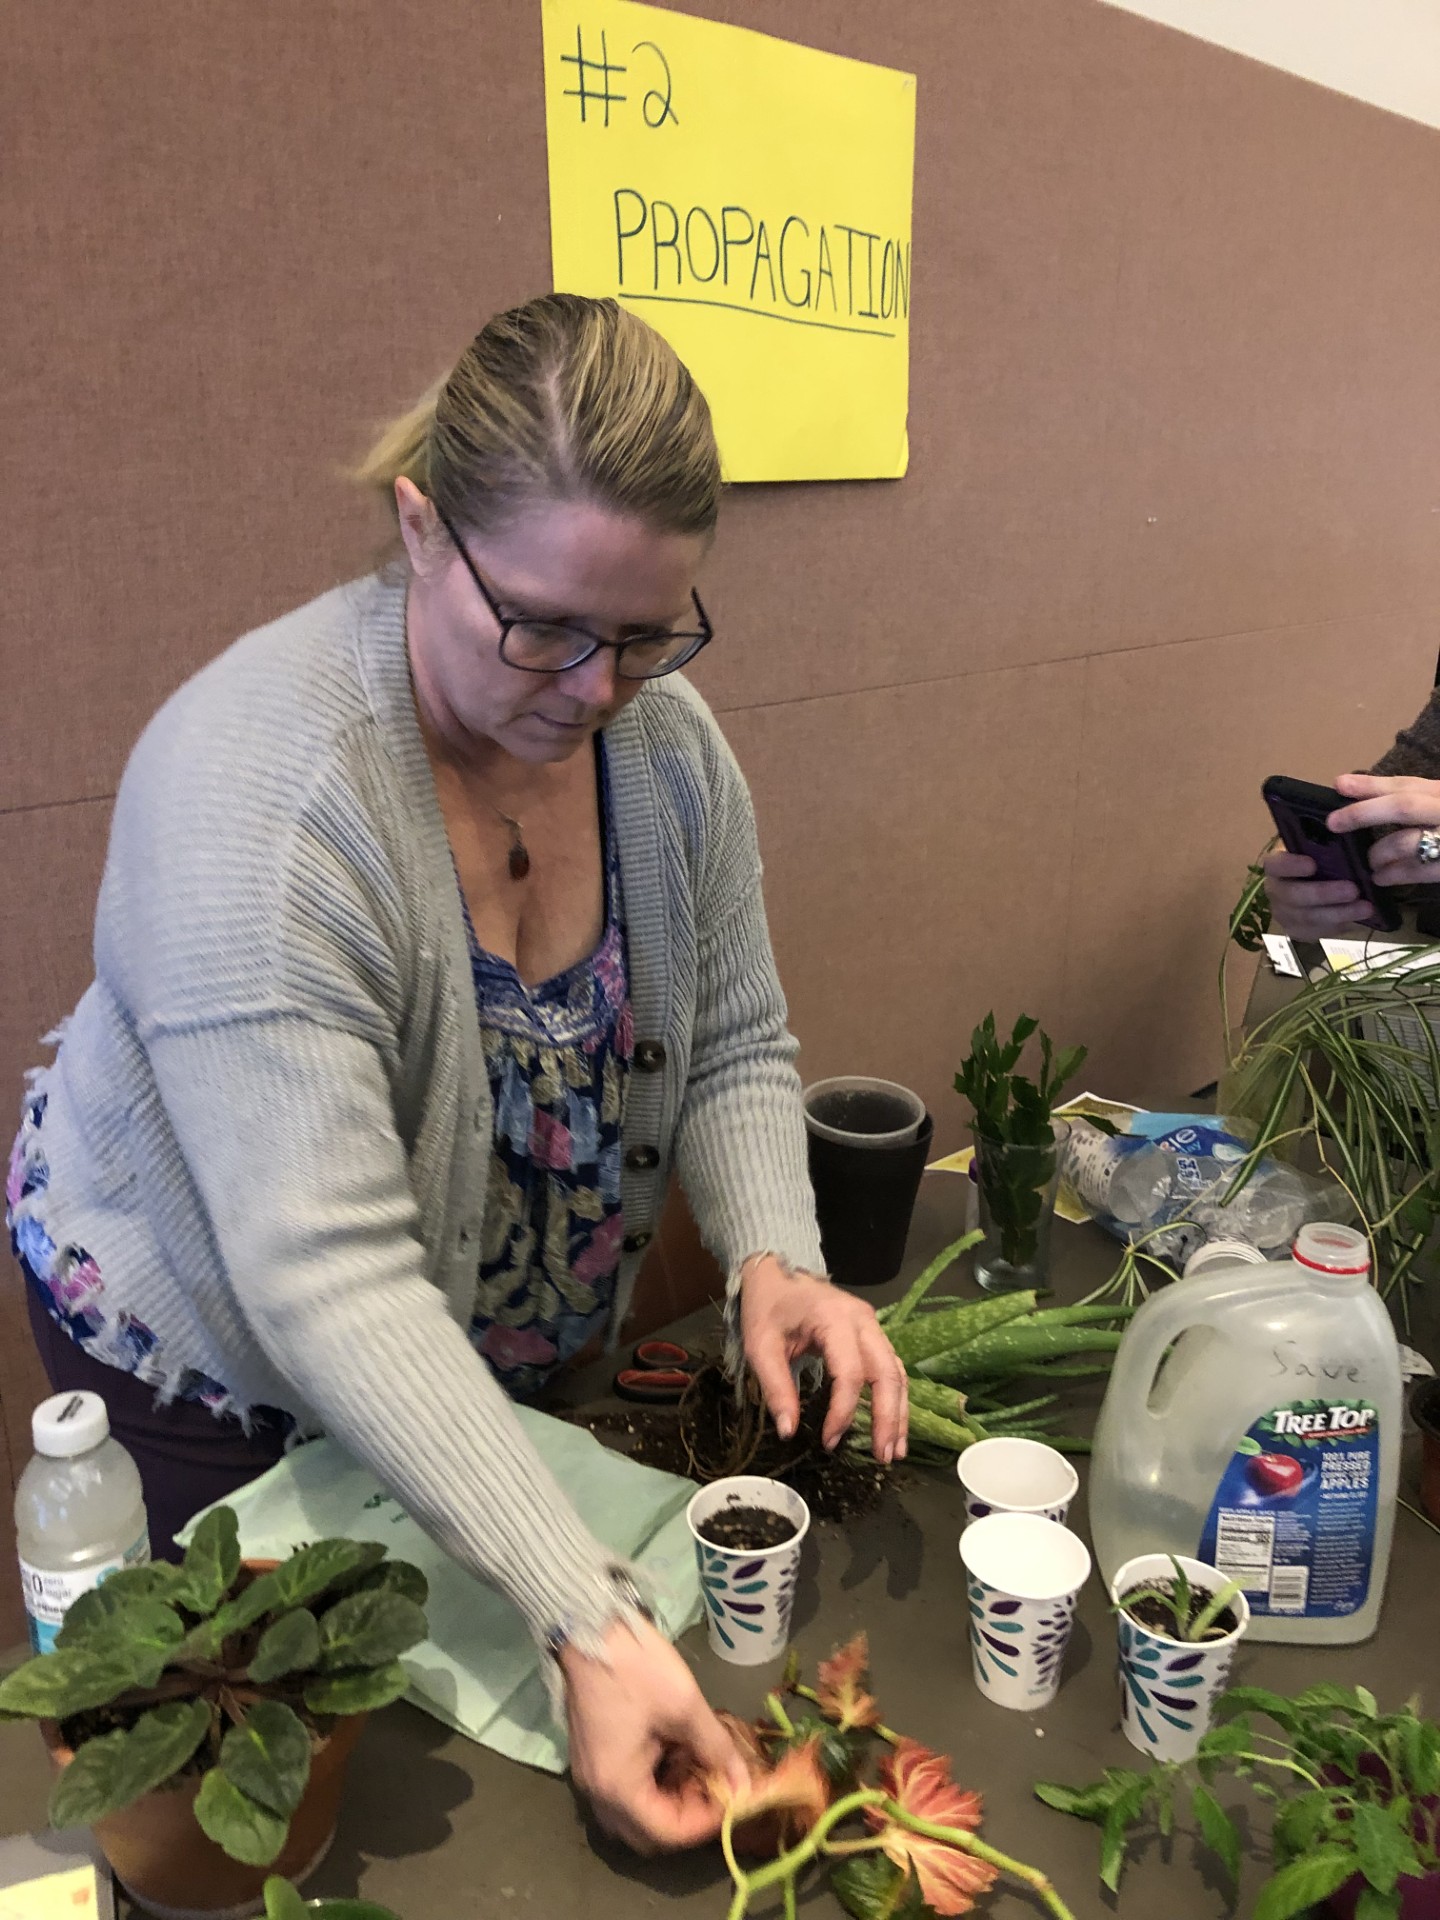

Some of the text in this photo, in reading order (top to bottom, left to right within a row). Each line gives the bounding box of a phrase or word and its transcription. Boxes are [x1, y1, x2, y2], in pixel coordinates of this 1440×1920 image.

[561, 25, 679, 128] #2
[614, 188, 910, 319] PROPAGATION
[1269, 1340, 1366, 1383] Save
